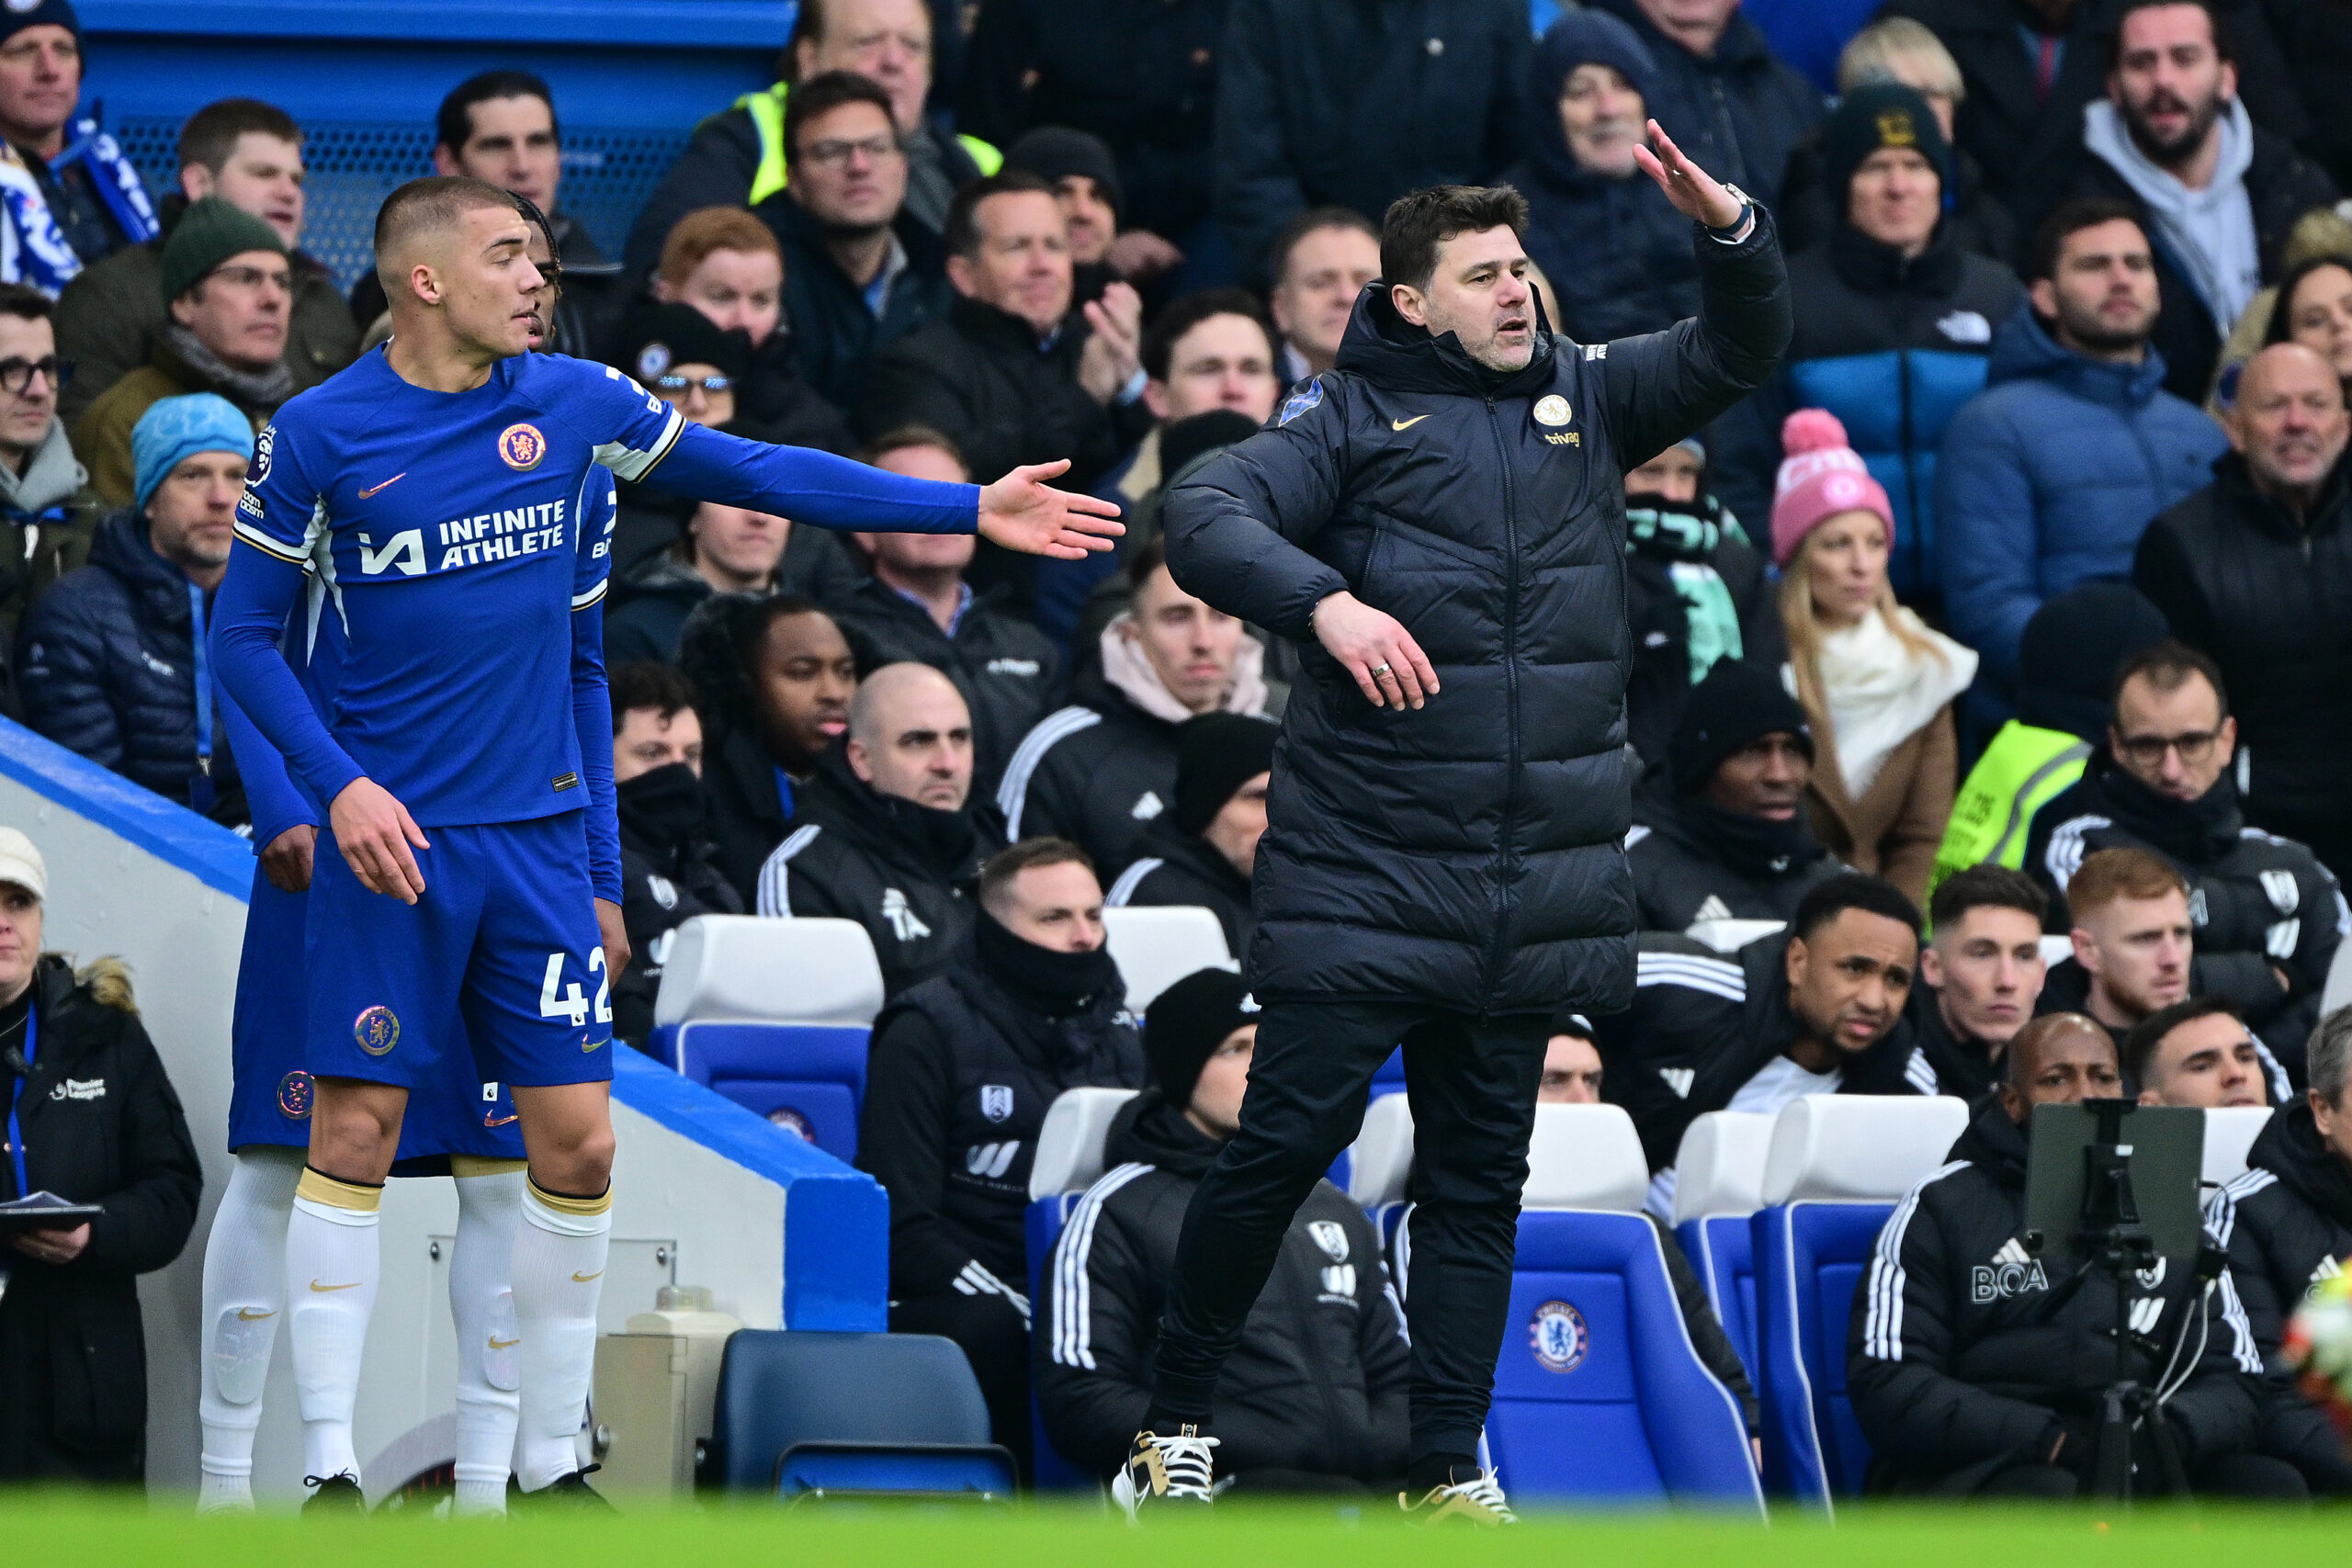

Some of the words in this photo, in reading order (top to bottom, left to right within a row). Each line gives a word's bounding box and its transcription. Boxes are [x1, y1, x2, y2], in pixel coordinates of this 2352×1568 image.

[1544, 432, 1579, 448] trivag
[242, 490, 262, 509] oom
[439, 499, 566, 546] INFINITE
[440, 524, 563, 570] ATHLETE
[539, 946, 614, 1027] 42
[1972, 1258, 2049, 1303] BOA
